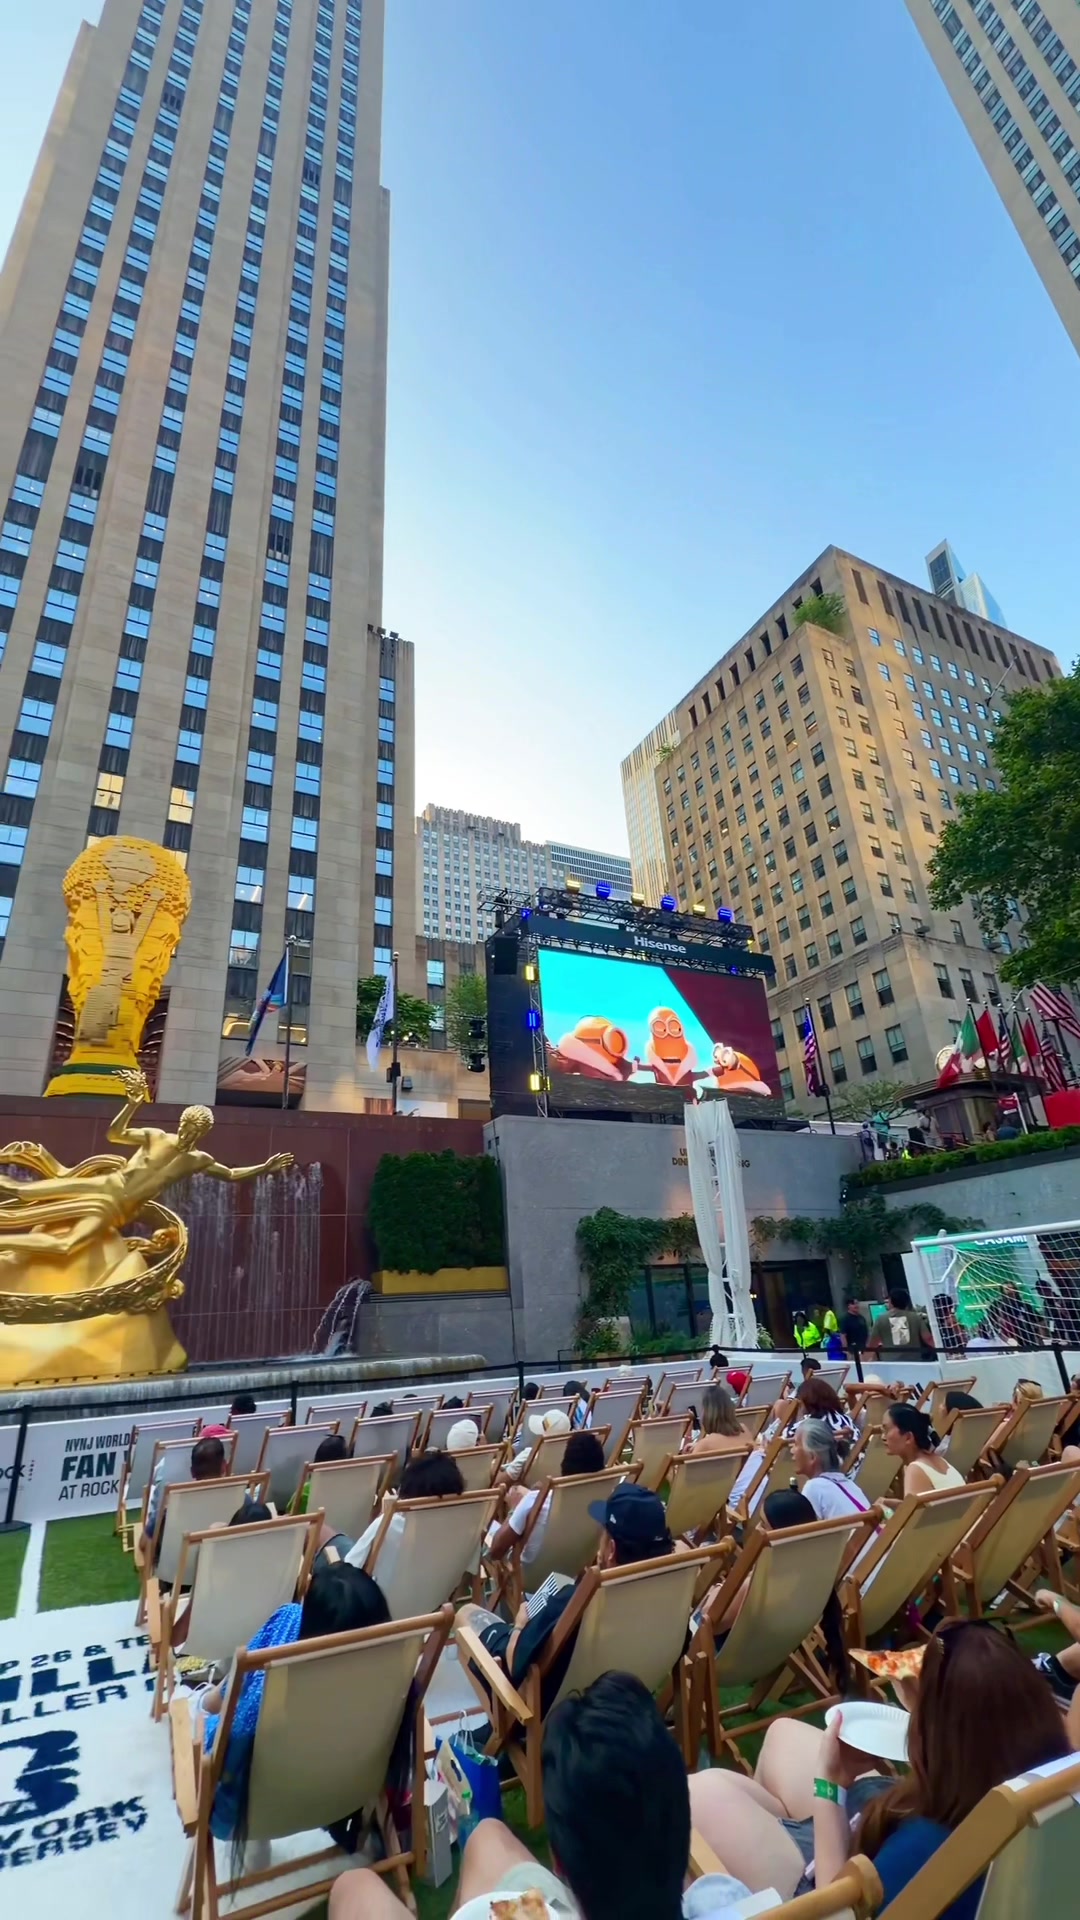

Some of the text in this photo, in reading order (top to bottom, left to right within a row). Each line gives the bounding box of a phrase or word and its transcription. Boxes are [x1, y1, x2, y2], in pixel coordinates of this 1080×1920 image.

[633, 935, 687, 954] Hisense
[65, 1436, 94, 1452] NYNJ
[95, 1433, 131, 1449] WORLD
[61, 1451, 117, 1482] FAN
[58, 1480, 120, 1501] AT ROCK
[31, 1649, 72, 1669] 26
[83, 1644, 106, 1657] &
